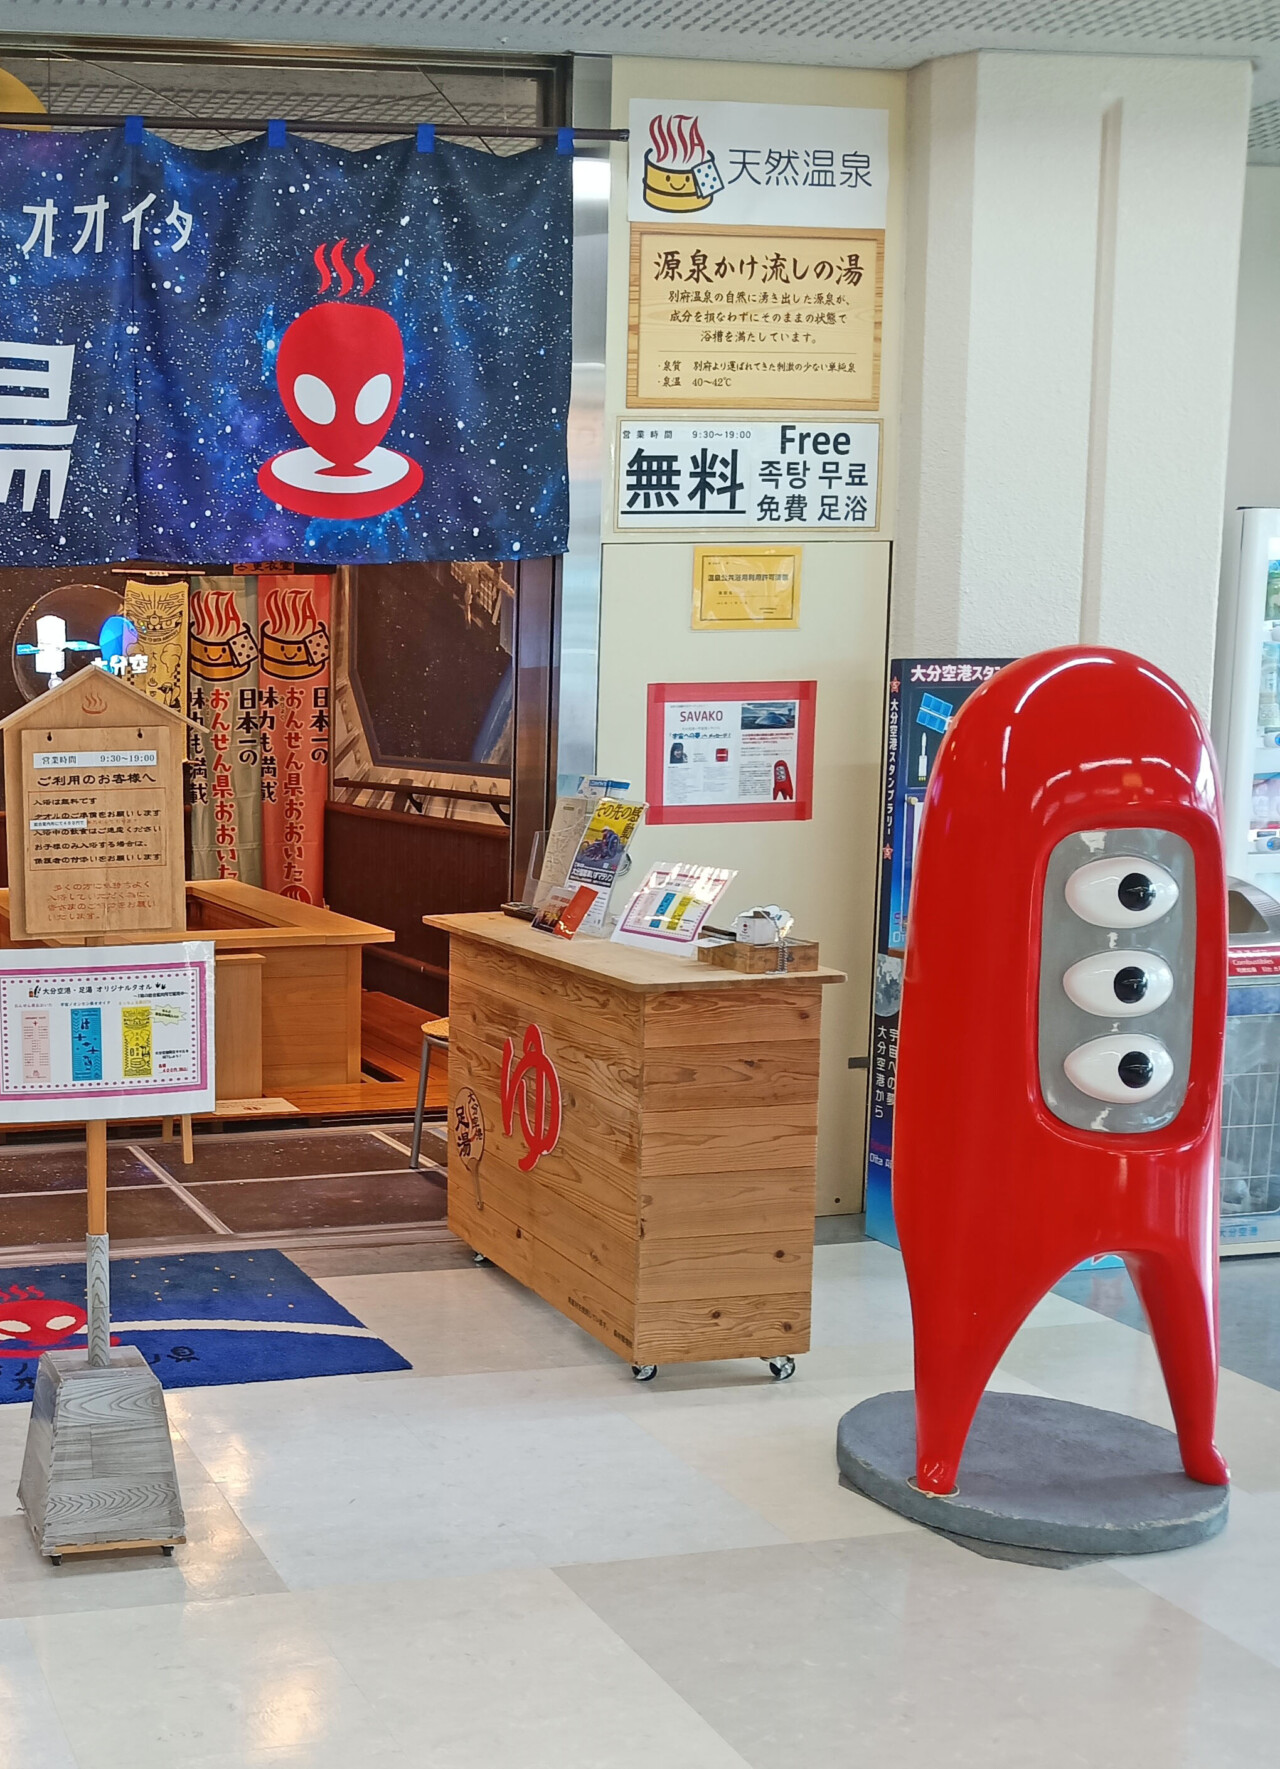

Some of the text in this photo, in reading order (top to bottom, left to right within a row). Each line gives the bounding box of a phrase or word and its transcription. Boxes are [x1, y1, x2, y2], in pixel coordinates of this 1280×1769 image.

[727, 148, 873, 188] 天然温泉
[653, 248, 865, 287] 源泉かけ流しの湯
[668, 289, 851, 306] 別府温泉の自然に湧き出した源泉が、
[669, 310, 848, 325] 成分を損なわずにそのままの状態で
[700, 330, 818, 344] 浴槽を満たしています。
[622, 429, 752, 440] 営業時間 9:30～19:00
[780, 425, 851, 455] Free
[625, 447, 745, 510] 無料
[758, 460, 869, 490] 족탕 무료
[756, 493, 868, 522] 免費 足浴
[234, 687, 260, 766] 日本一の
[308, 686, 329, 765] 日本一の
[680, 710, 724, 722] SAVAKO
[42, 754, 155, 765] 営業時間 9:30～19:00
[886, 698, 899, 835] 大分空港スタンプラリー
[37, 773, 157, 787] ご利用のお客様へ
[209, 688, 239, 880] おんせん県おおいた
[282, 686, 306, 883] おんせん県おおいた
[33, 797, 98, 806] 入浴は無料です
[42, 984, 153, 995] 大分空港・足湯 オリジナルタオル
[874, 1025, 887, 1119] 大分空港から
[499, 1022, 563, 1172] ゆ
[455, 1105, 472, 1157] 足湯
